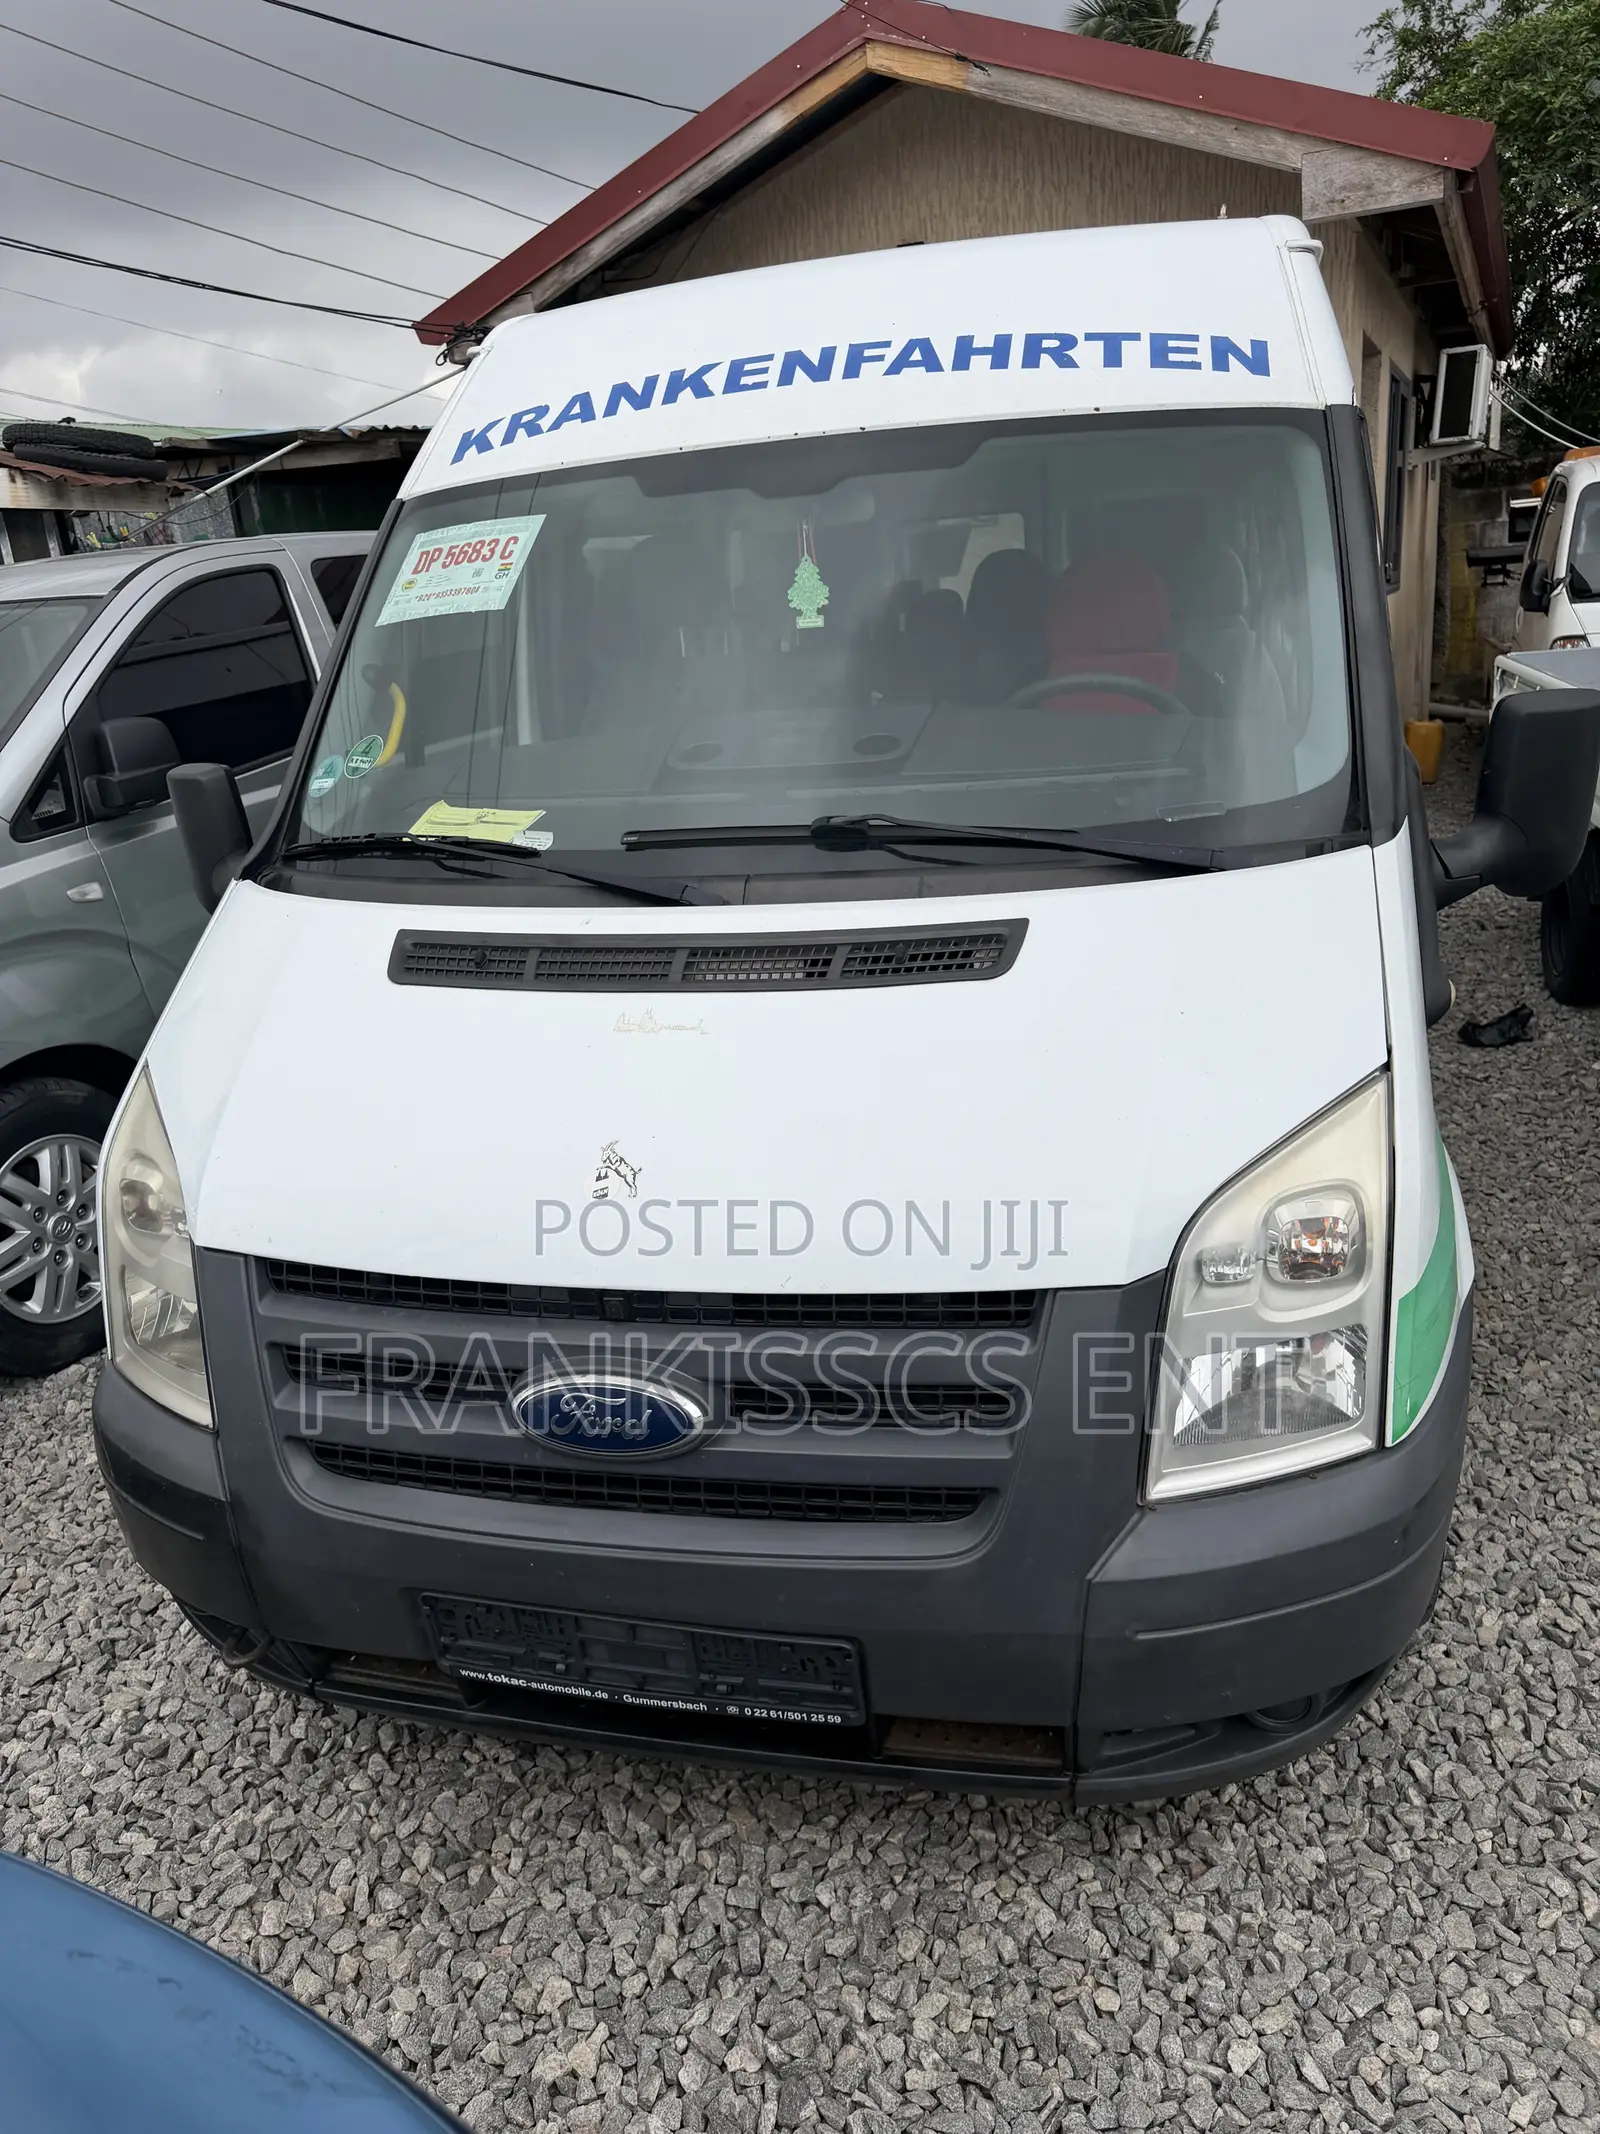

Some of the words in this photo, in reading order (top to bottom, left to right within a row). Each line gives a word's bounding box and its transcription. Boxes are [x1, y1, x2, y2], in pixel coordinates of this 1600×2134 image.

[450, 331, 1271, 465] KRANKENFAHRTEN
[411, 547, 443, 575] DP
[442, 537, 501, 569] 5683
[499, 535, 519, 560] C
[494, 572, 510, 580] GH
[361, 738, 376, 757] 4
[550, 1392, 653, 1441] Ford
[459, 1668, 609, 1700] www.tokac-automobile.de
[623, 1693, 708, 1712] Gummersbach
[744, 1707, 752, 1716] 0
[754, 1708, 768, 1718] 22
[770, 1709, 808, 1722] 61/501
[811, 1712, 825, 1722] 25
[827, 1713, 842, 1724] 59
